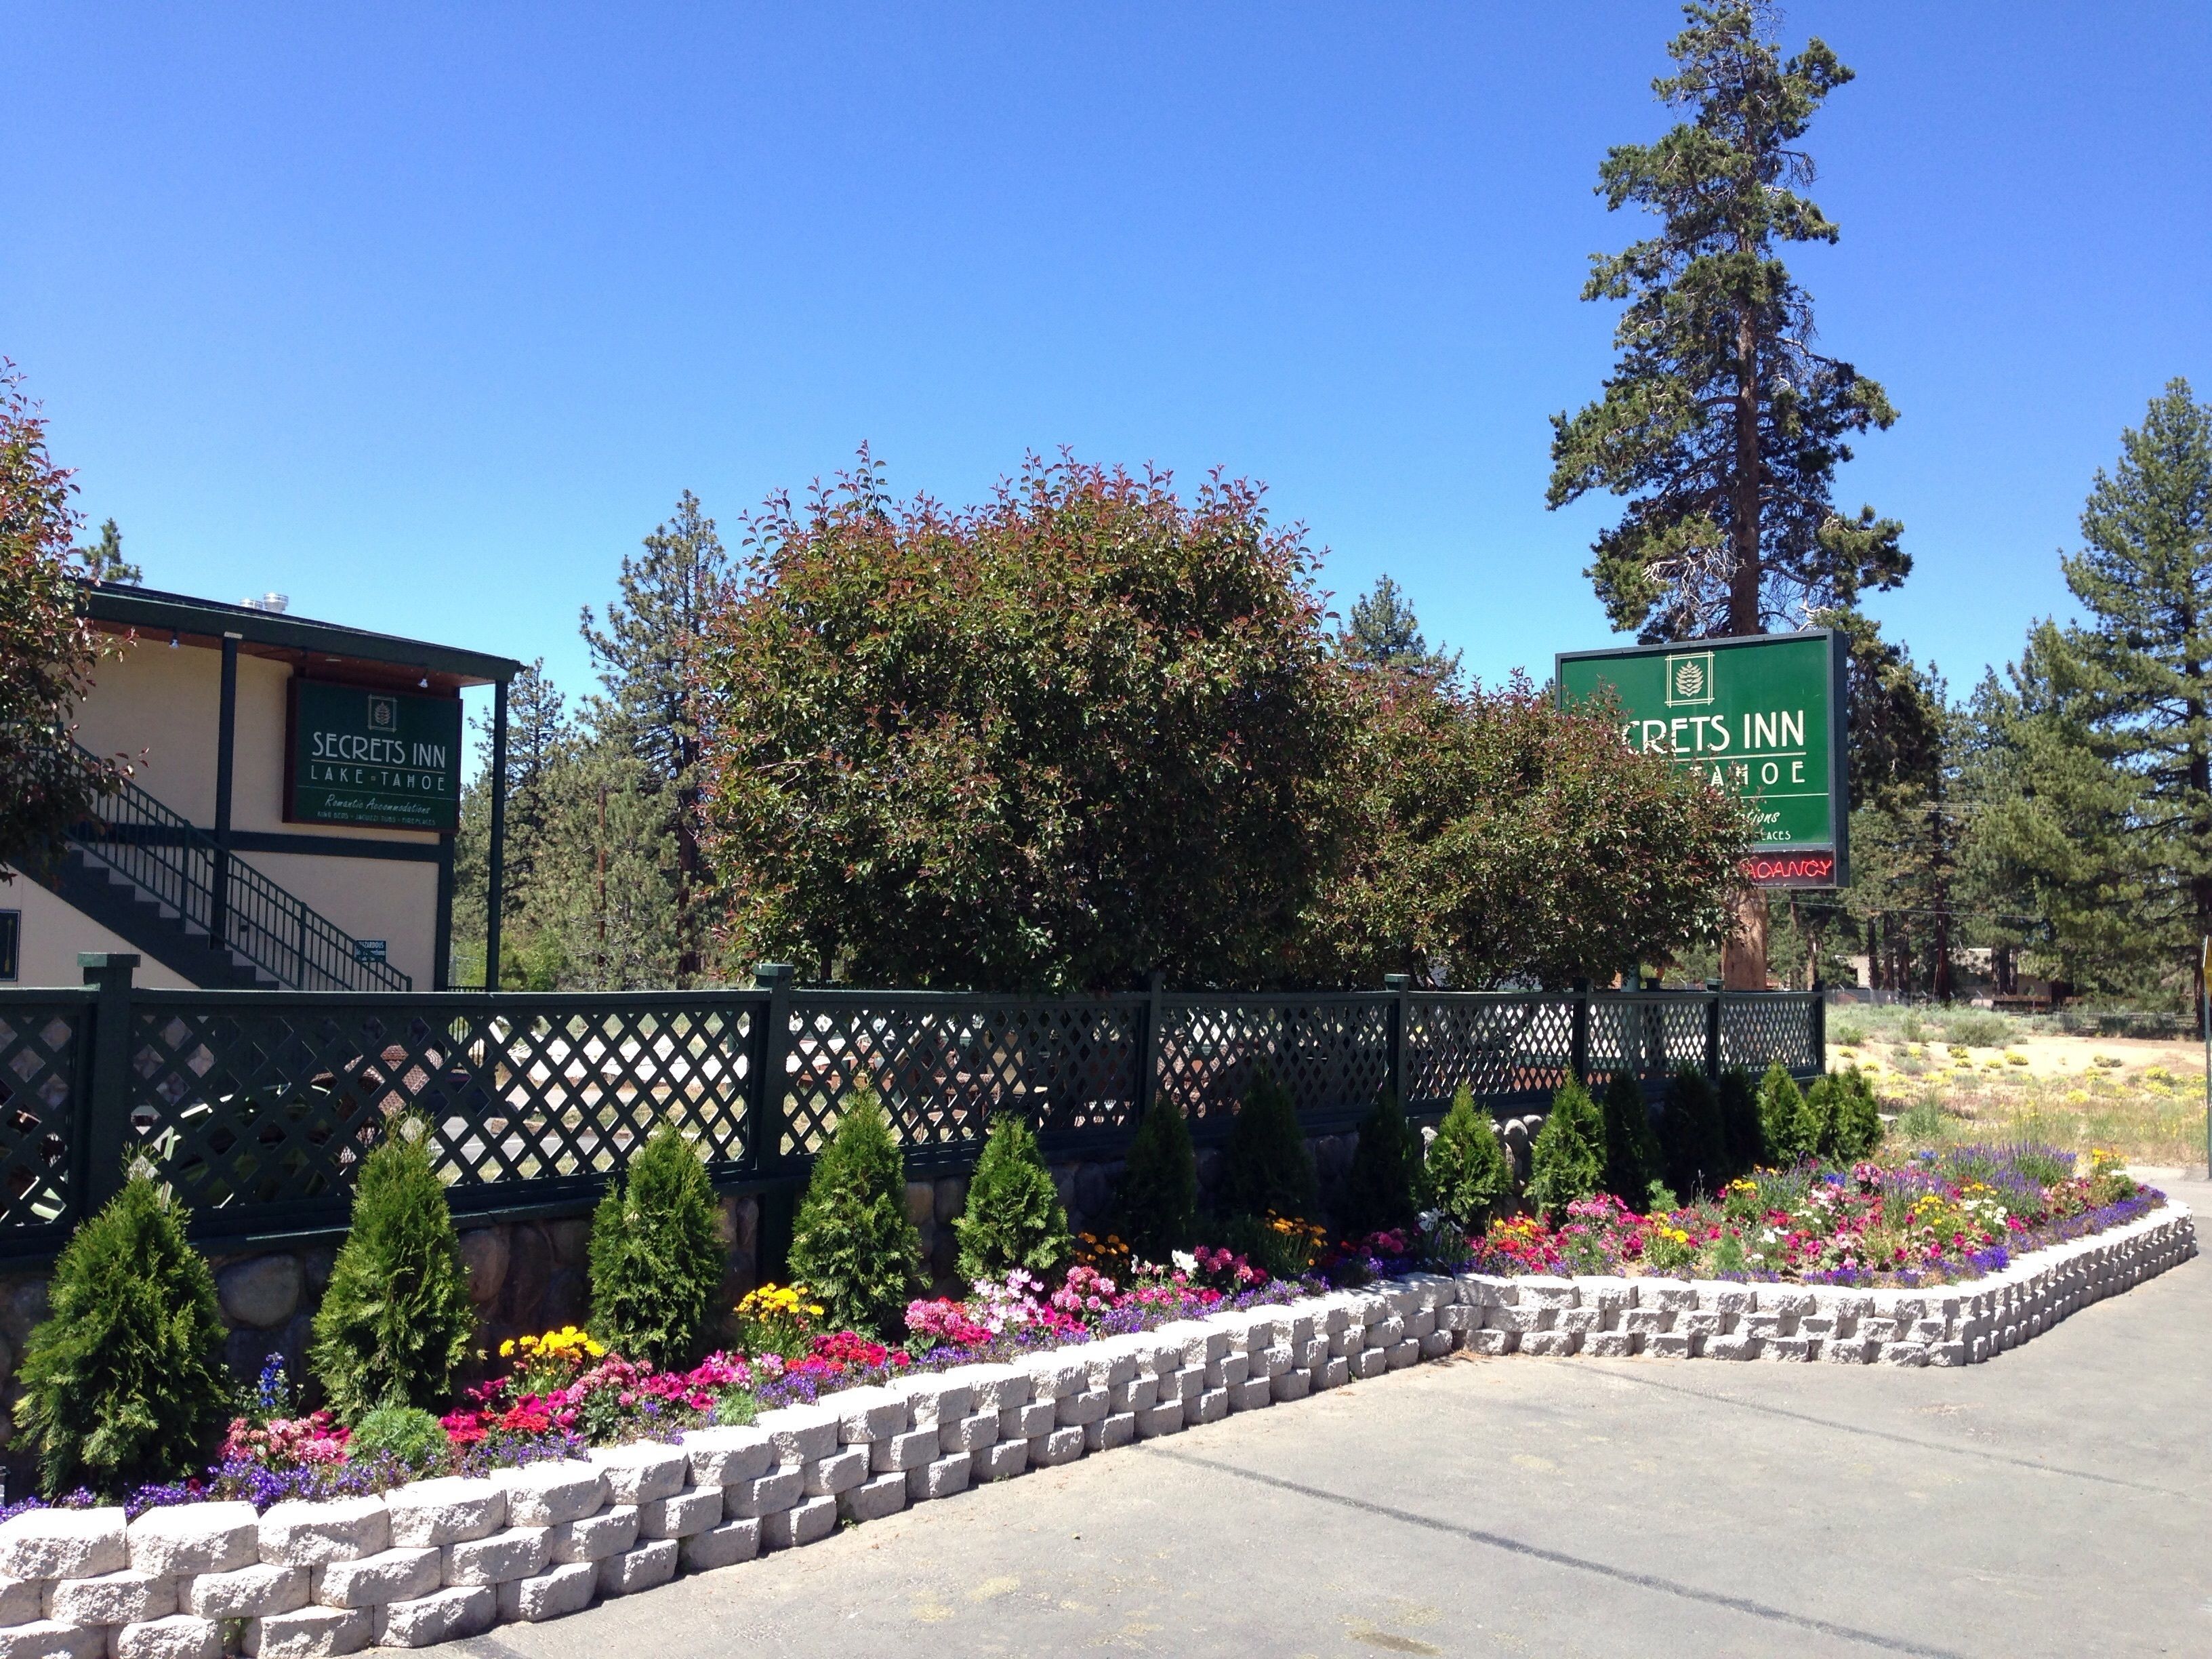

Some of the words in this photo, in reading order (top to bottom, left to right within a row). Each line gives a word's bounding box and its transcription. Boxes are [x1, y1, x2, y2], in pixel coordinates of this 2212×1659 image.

[1621, 714, 1730, 754] CRETS
[1744, 710, 1804, 749] INN
[312, 731, 406, 764] SECRETS
[413, 742, 445, 768] INN
[310, 764, 363, 784] LAKE
[381, 771, 445, 792] TAHOE
[325, 793, 363, 809] Romantic
[365, 797, 431, 814] Accommodations
[1746, 859, 1832, 879] ACANCY
